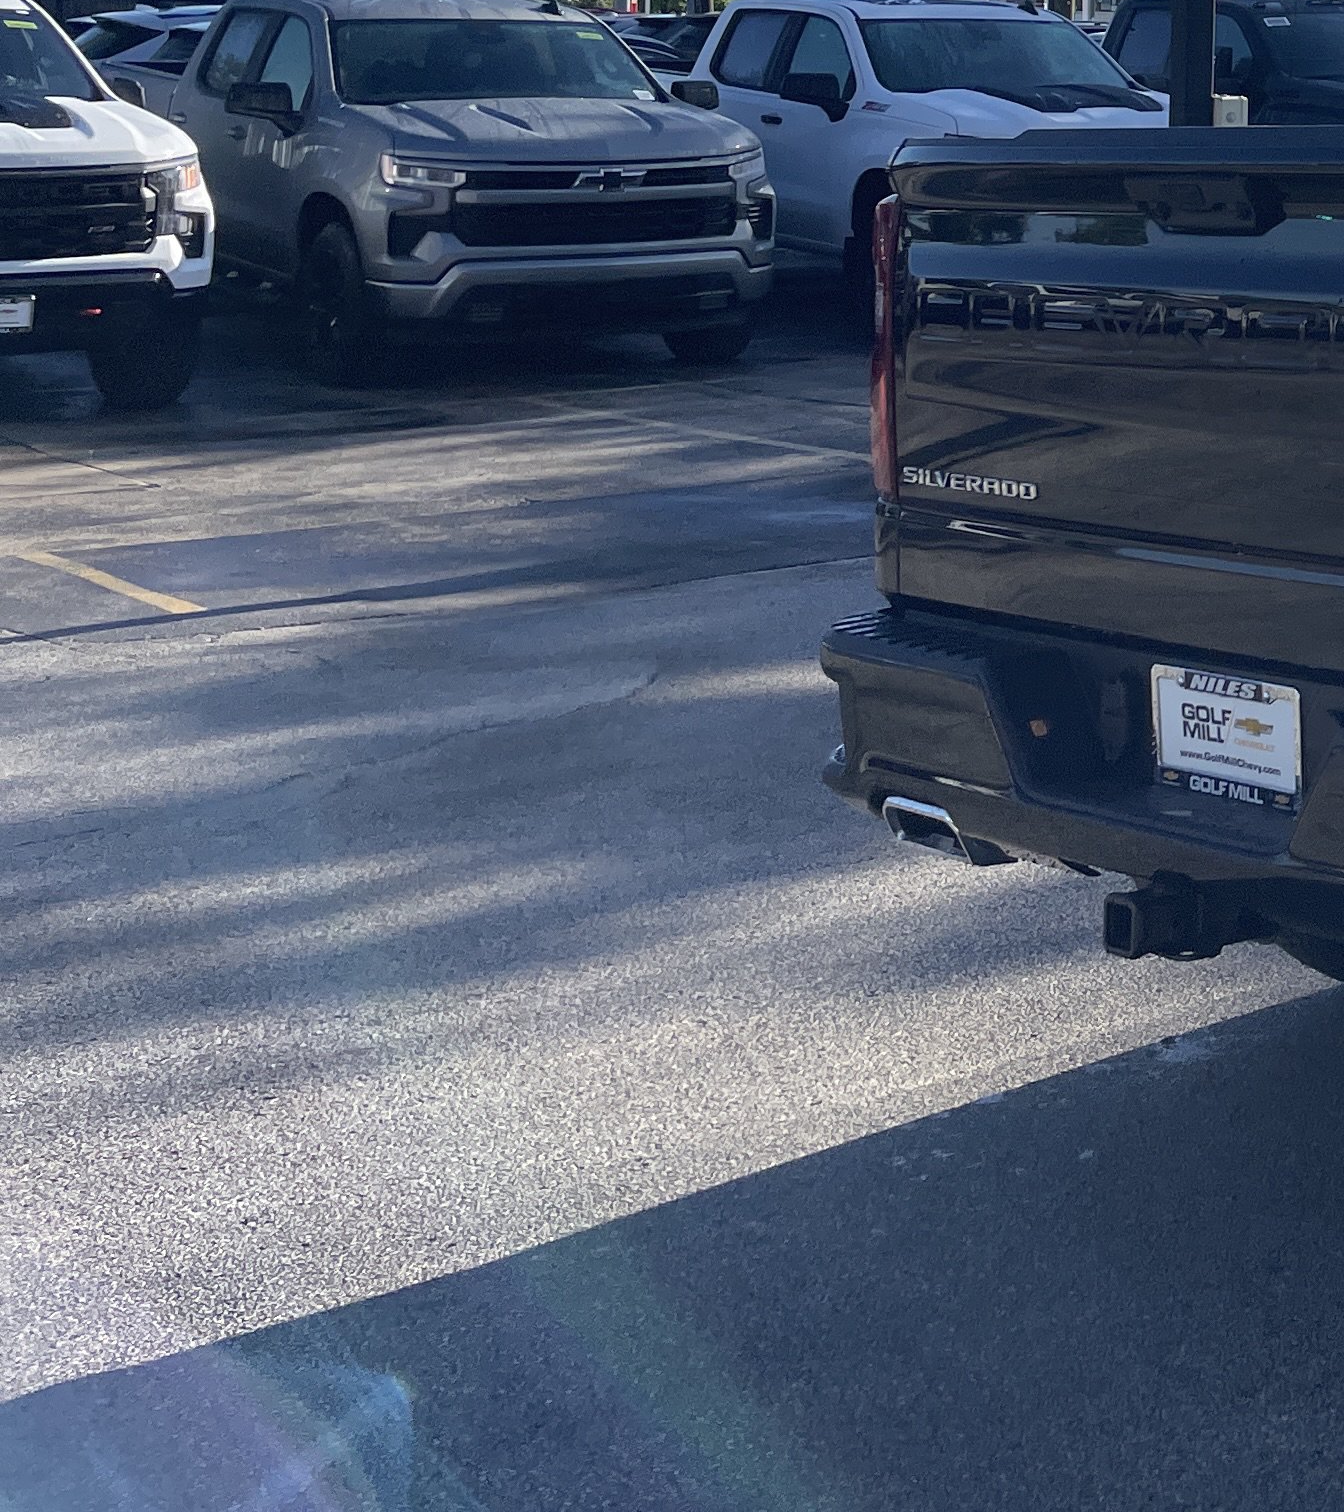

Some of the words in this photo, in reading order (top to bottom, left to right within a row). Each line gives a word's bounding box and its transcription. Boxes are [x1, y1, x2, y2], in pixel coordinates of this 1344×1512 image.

[903, 466, 1037, 500] SILVERADO
[1189, 674, 1257, 699] NILES
[1181, 702, 1232, 726] GOLF
[1183, 720, 1225, 744] MILL
[1180, 750, 1281, 777] www.GolfMillChevy.com
[1189, 775, 1227, 796] GOLF
[1228, 783, 1264, 805] MILL
